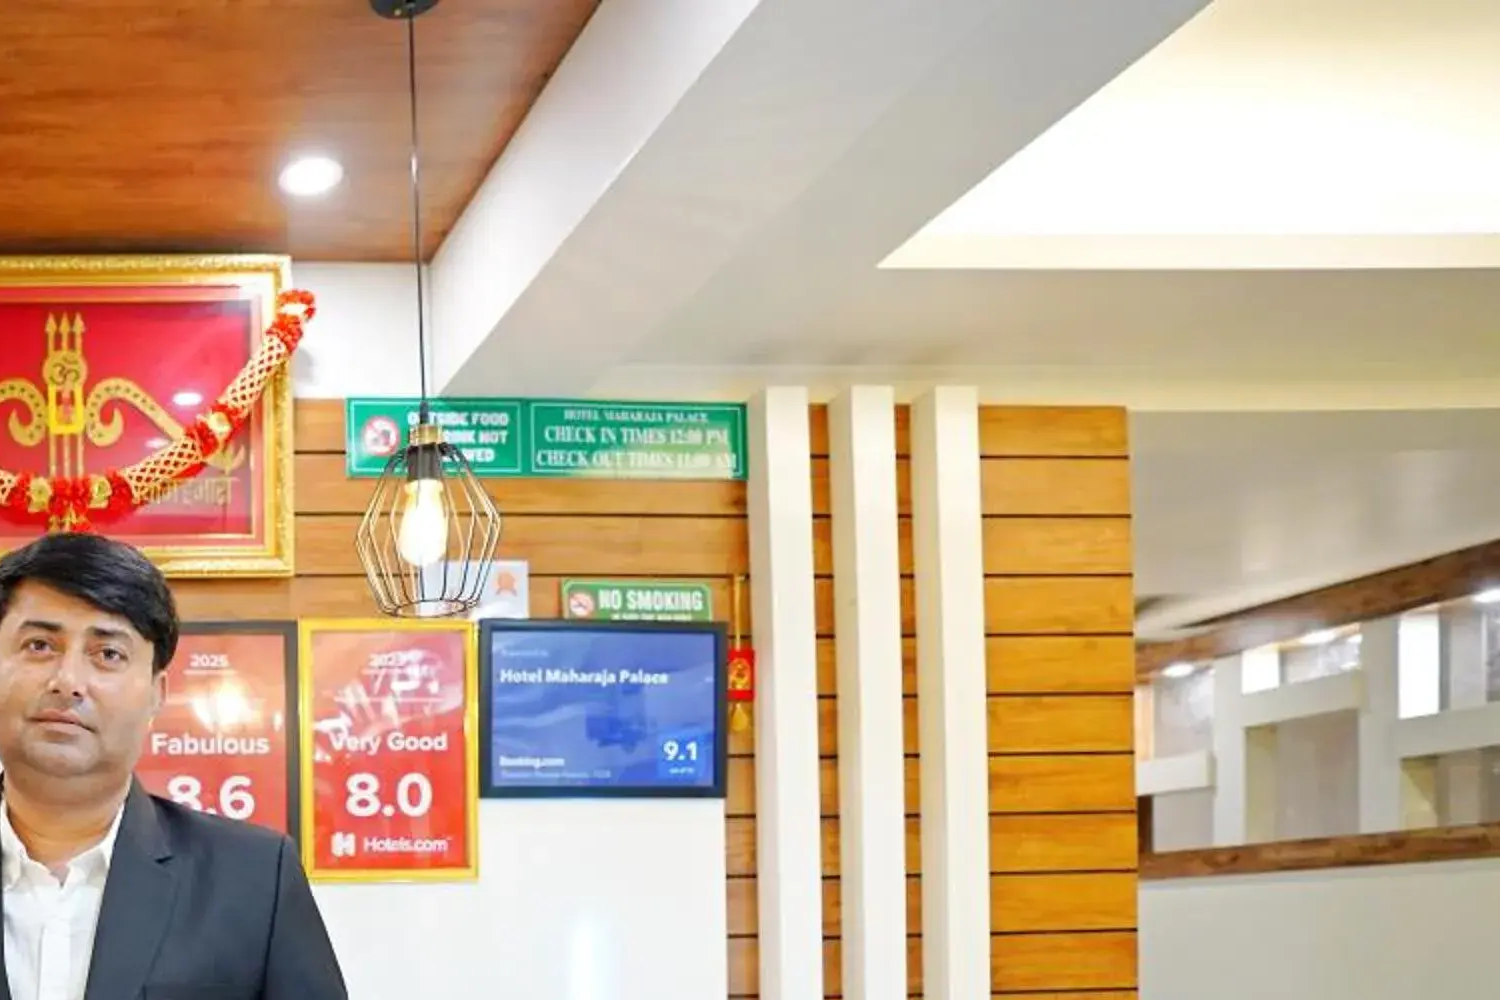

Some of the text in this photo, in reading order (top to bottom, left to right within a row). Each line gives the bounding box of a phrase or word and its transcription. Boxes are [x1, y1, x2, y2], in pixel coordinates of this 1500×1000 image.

[407, 411, 509, 427] OTSIDE FOOD
[564, 409, 600, 421] HOTEL
[478, 430, 509, 445] NOT
[544, 425, 596, 443] CHECK
[600, 427, 618, 443] IN
[620, 427, 666, 444] TIMES
[536, 449, 589, 467] CHECK
[592, 450, 624, 468] OUT
[597, 588, 704, 611] NO SMOKING
[189, 653, 230, 668] 2025
[500, 667, 669, 688] Hotel Maharaja Palace
[151, 731, 271, 755] Fabulous
[330, 731, 448, 756] Very Good
[662, 740, 698, 761] 9.1
[167, 774, 256, 821] 8.6
[345, 772, 433, 818] 8.0
[363, 836, 448, 853] Hotels.com
